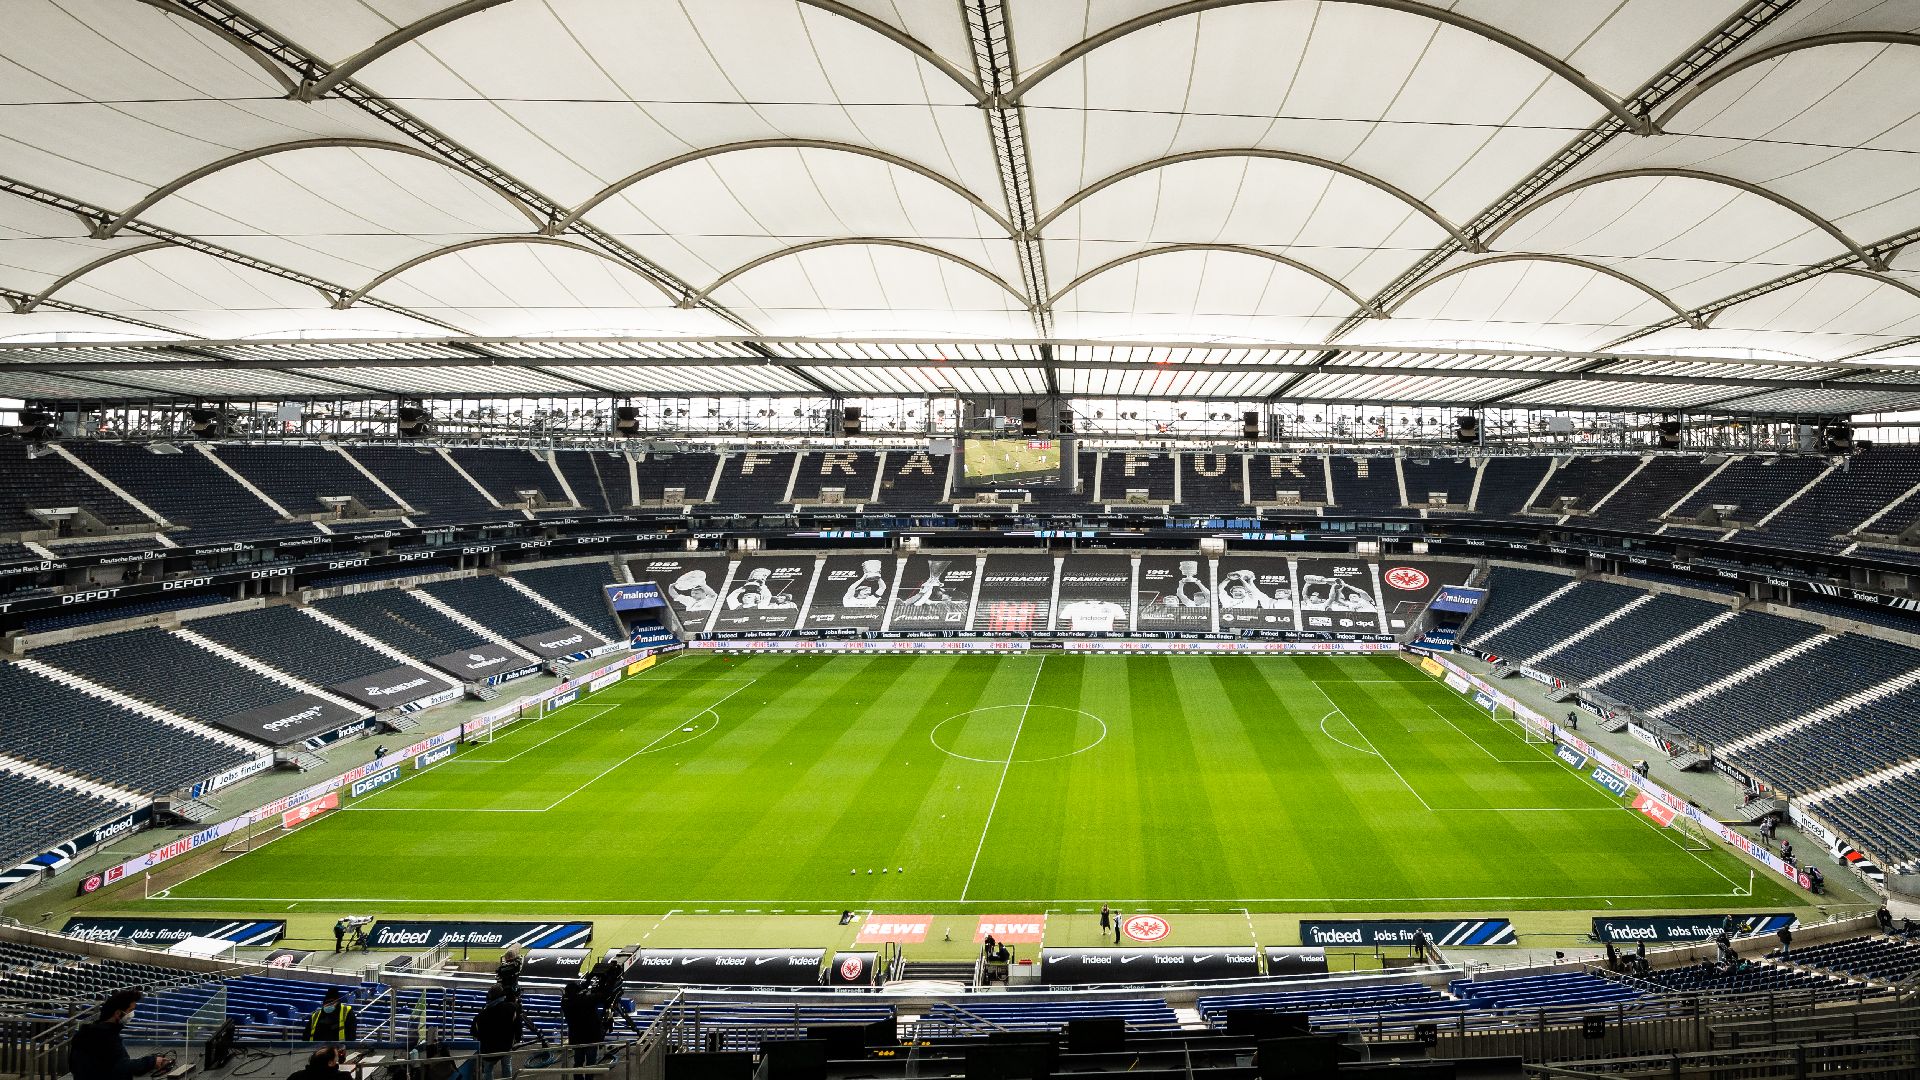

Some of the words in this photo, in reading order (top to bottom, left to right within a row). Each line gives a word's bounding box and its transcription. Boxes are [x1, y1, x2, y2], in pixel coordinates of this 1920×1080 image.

[463, 546, 496, 554] DEPOT
[400, 552, 435, 561] DEPOT
[329, 558, 370, 569] DEPOT
[252, 567, 296, 579] DEPOT
[163, 577, 213, 590] DEPOT
[63, 589, 120, 604] DEPOT
[622, 591, 658, 599] mainova
[1445, 594, 1478, 605] mainova
[641, 634, 673, 643] mainova
[337, 721, 365, 737] indeed
[424, 747, 451, 765] indeed
[1558, 745, 1577, 764] indeed
[220, 773, 238, 785] Jobs
[241, 760, 266, 776] finden
[1714, 759, 1727, 772] Jobs
[1727, 765, 1746, 783] finden
[357, 768, 399, 795] DEPOT
[1592, 769, 1625, 796] DEPOT
[93, 815, 133, 842] indeed
[70, 924, 123, 941] indeed
[129, 929, 156, 939] Jobs
[156, 928, 192, 939] finden
[864, 924, 926, 934] REWE
[979, 924, 1040, 935] REWE
[1310, 926, 1362, 943] indeed
[1374, 930, 1397, 941] Jobs
[1604, 923, 1657, 939] indeed
[1667, 926, 1690, 937] Jobs
[1691, 925, 1725, 937] finden
[378, 927, 431, 944] indeed
[439, 932, 465, 943] Jobs
[466, 931, 502, 943] finden
[557, 956, 581, 965] indeed
[642, 956, 673, 966] indeed
[715, 956, 747, 966] indeed
[788, 956, 819, 965] indeed
[1081, 955, 1111, 964] indeed
[1153, 954, 1184, 964] indeed
[1225, 954, 1256, 963] indeed
[1299, 954, 1324, 962] indeed
